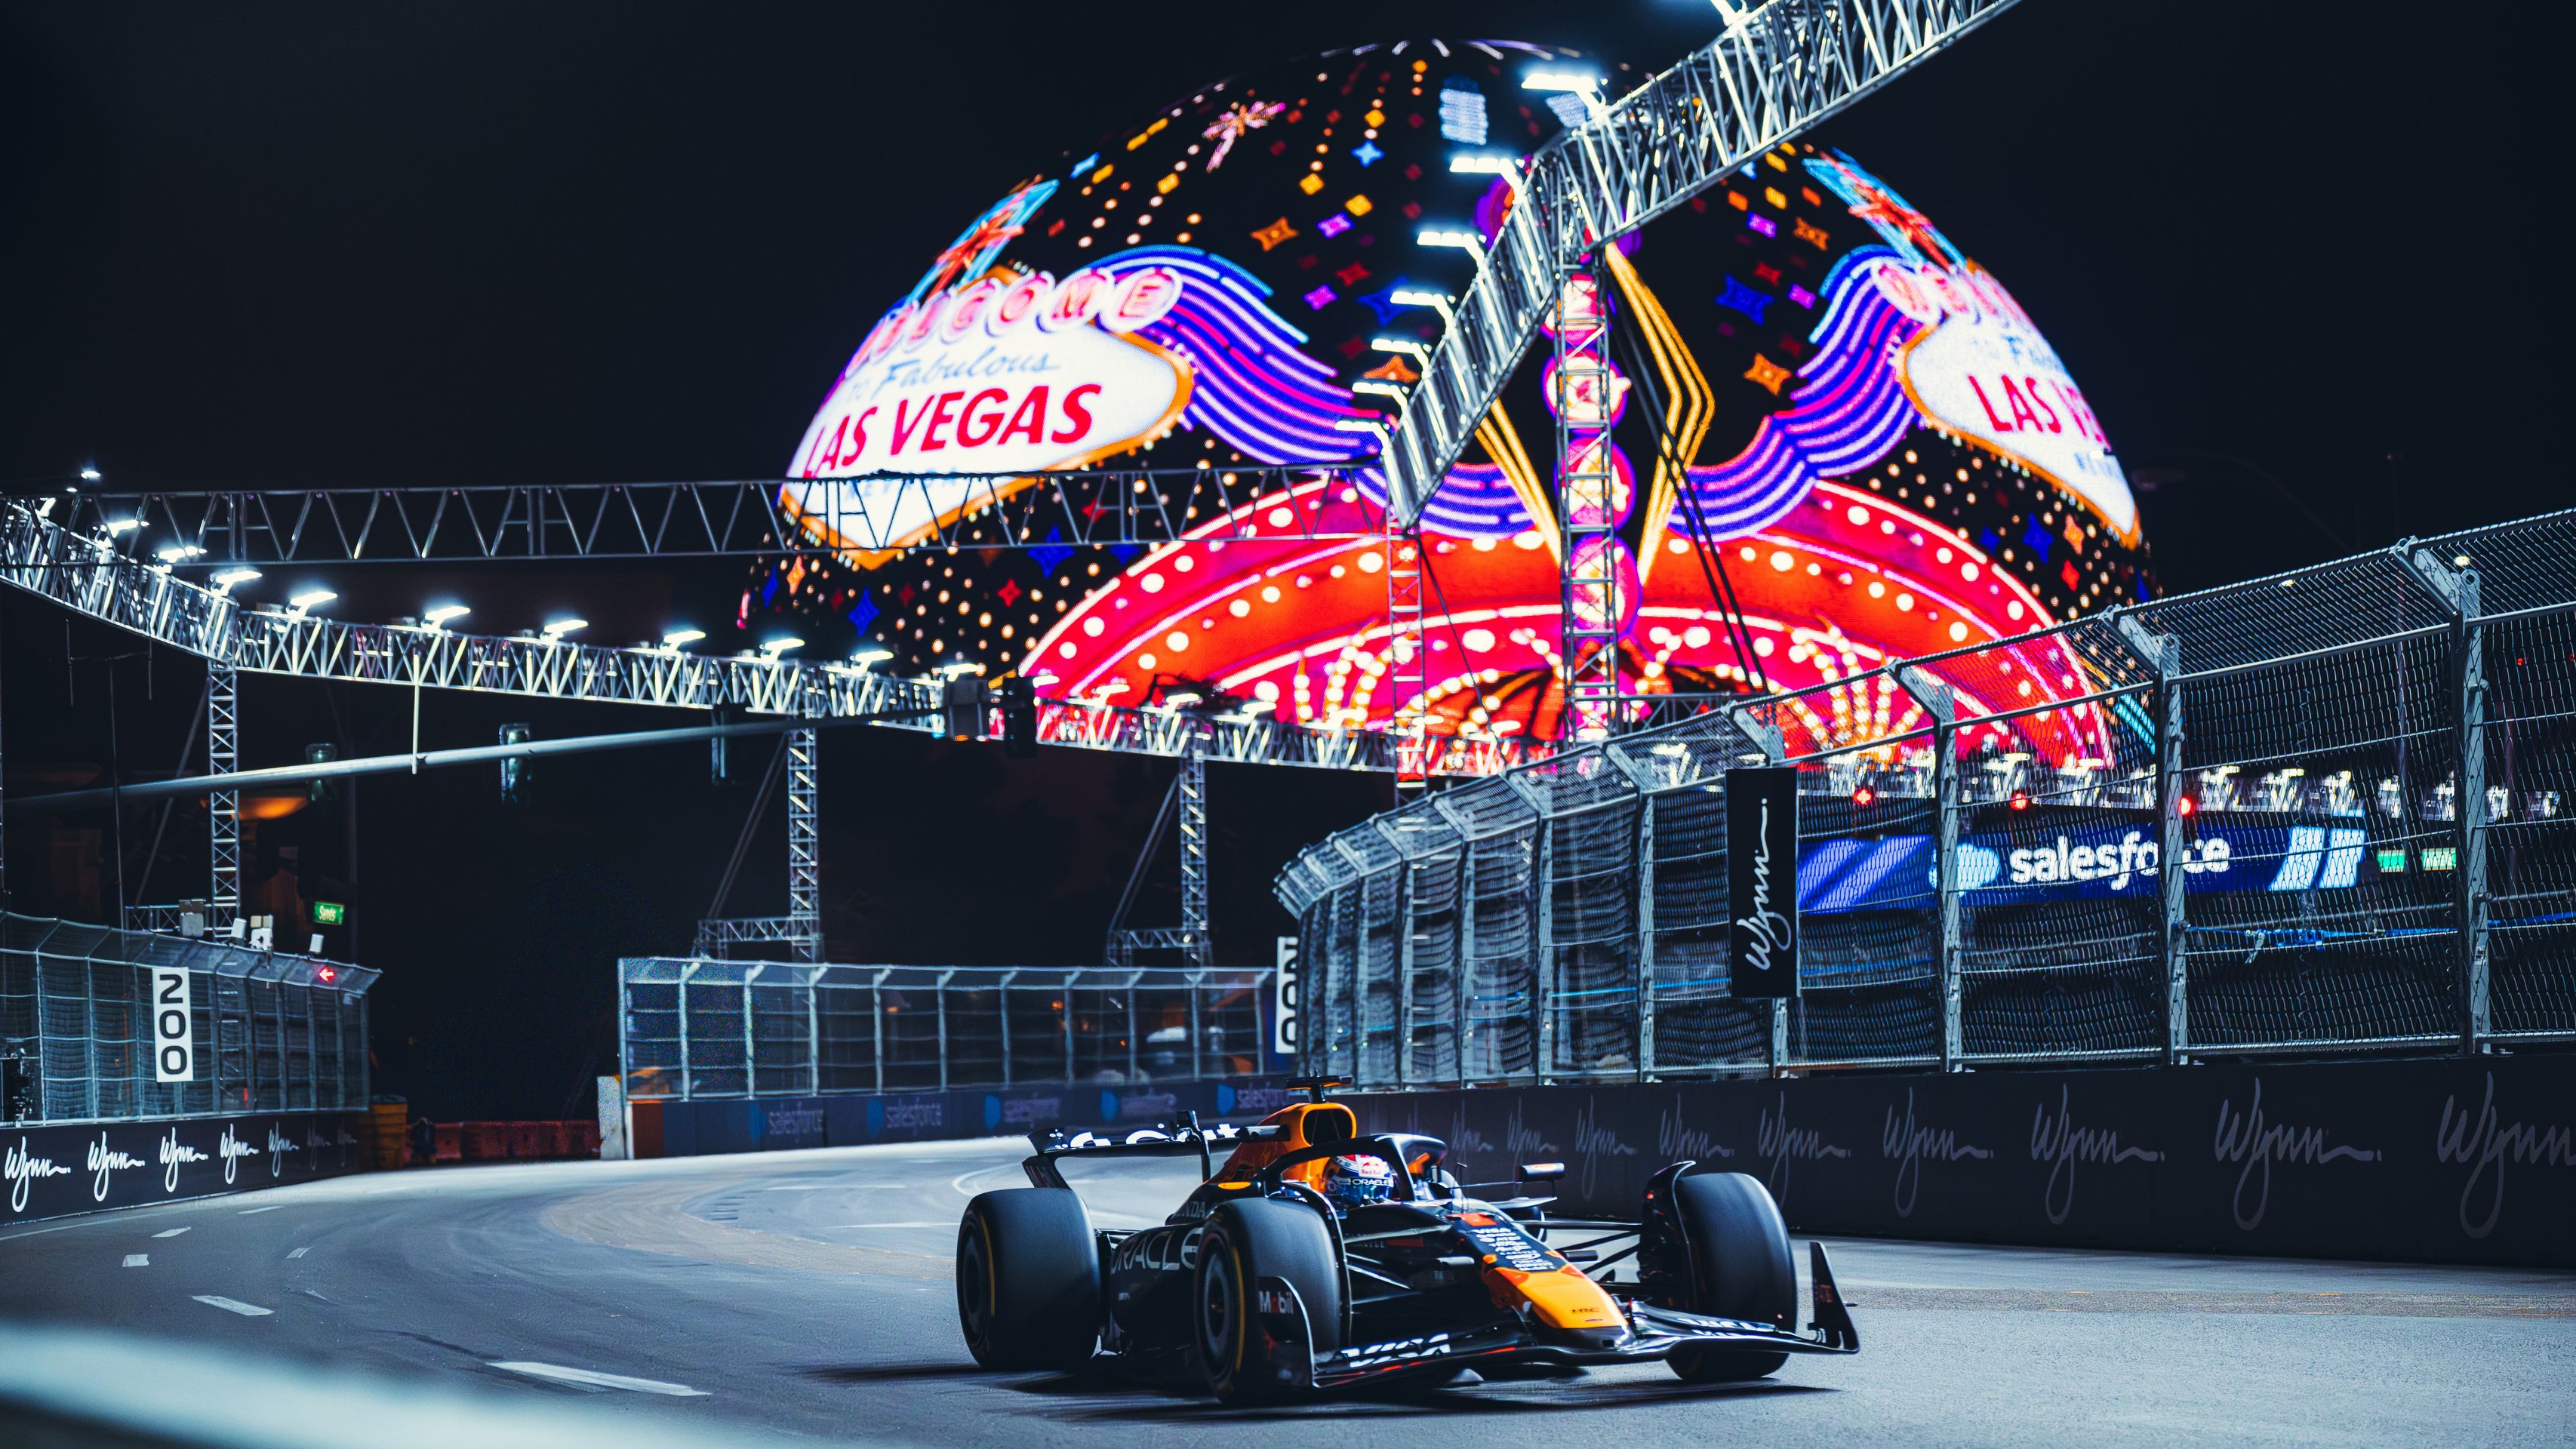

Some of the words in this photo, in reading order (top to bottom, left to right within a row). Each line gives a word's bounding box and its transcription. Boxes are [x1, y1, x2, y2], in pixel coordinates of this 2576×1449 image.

[870, 345, 1060, 400] Fabulous
[1967, 375, 2062, 433] LAS
[802, 406, 878, 478] LAS
[889, 383, 1102, 456] VEGAS
[2008, 830, 2232, 891] salesfoce
[159, 974, 187, 1075] 200
[5, 1136, 71, 1212] Wynn
[88, 1131, 145, 1201] Wynn
[160, 1127, 208, 1192] Wynn
